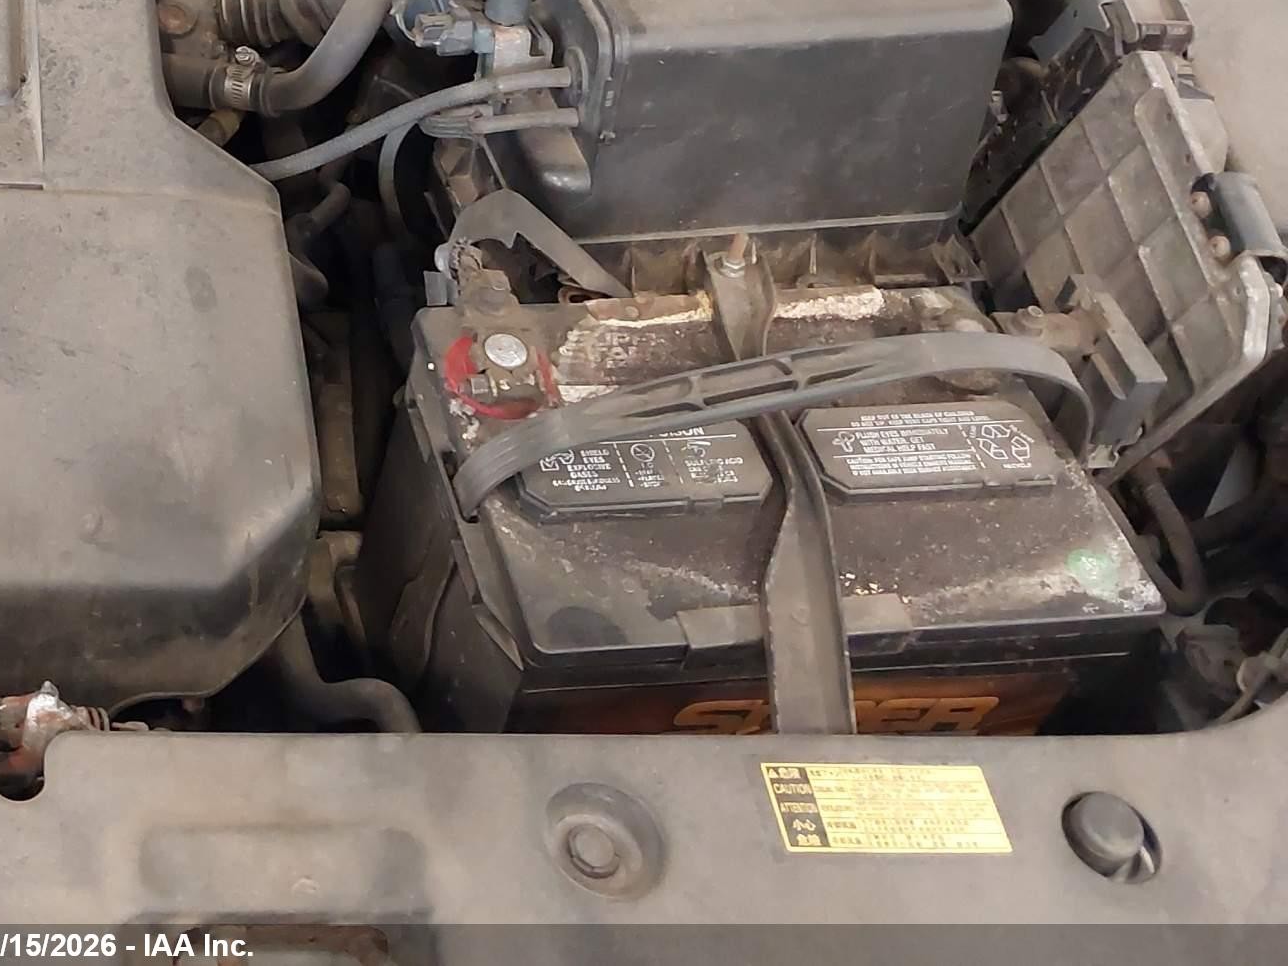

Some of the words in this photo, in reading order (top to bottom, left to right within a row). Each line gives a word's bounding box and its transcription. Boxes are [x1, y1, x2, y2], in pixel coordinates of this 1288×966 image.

[582, 456, 606, 464] EYES
[567, 463, 612, 472] EXPLOSIVE
[773, 782, 812, 795] CAUTION
